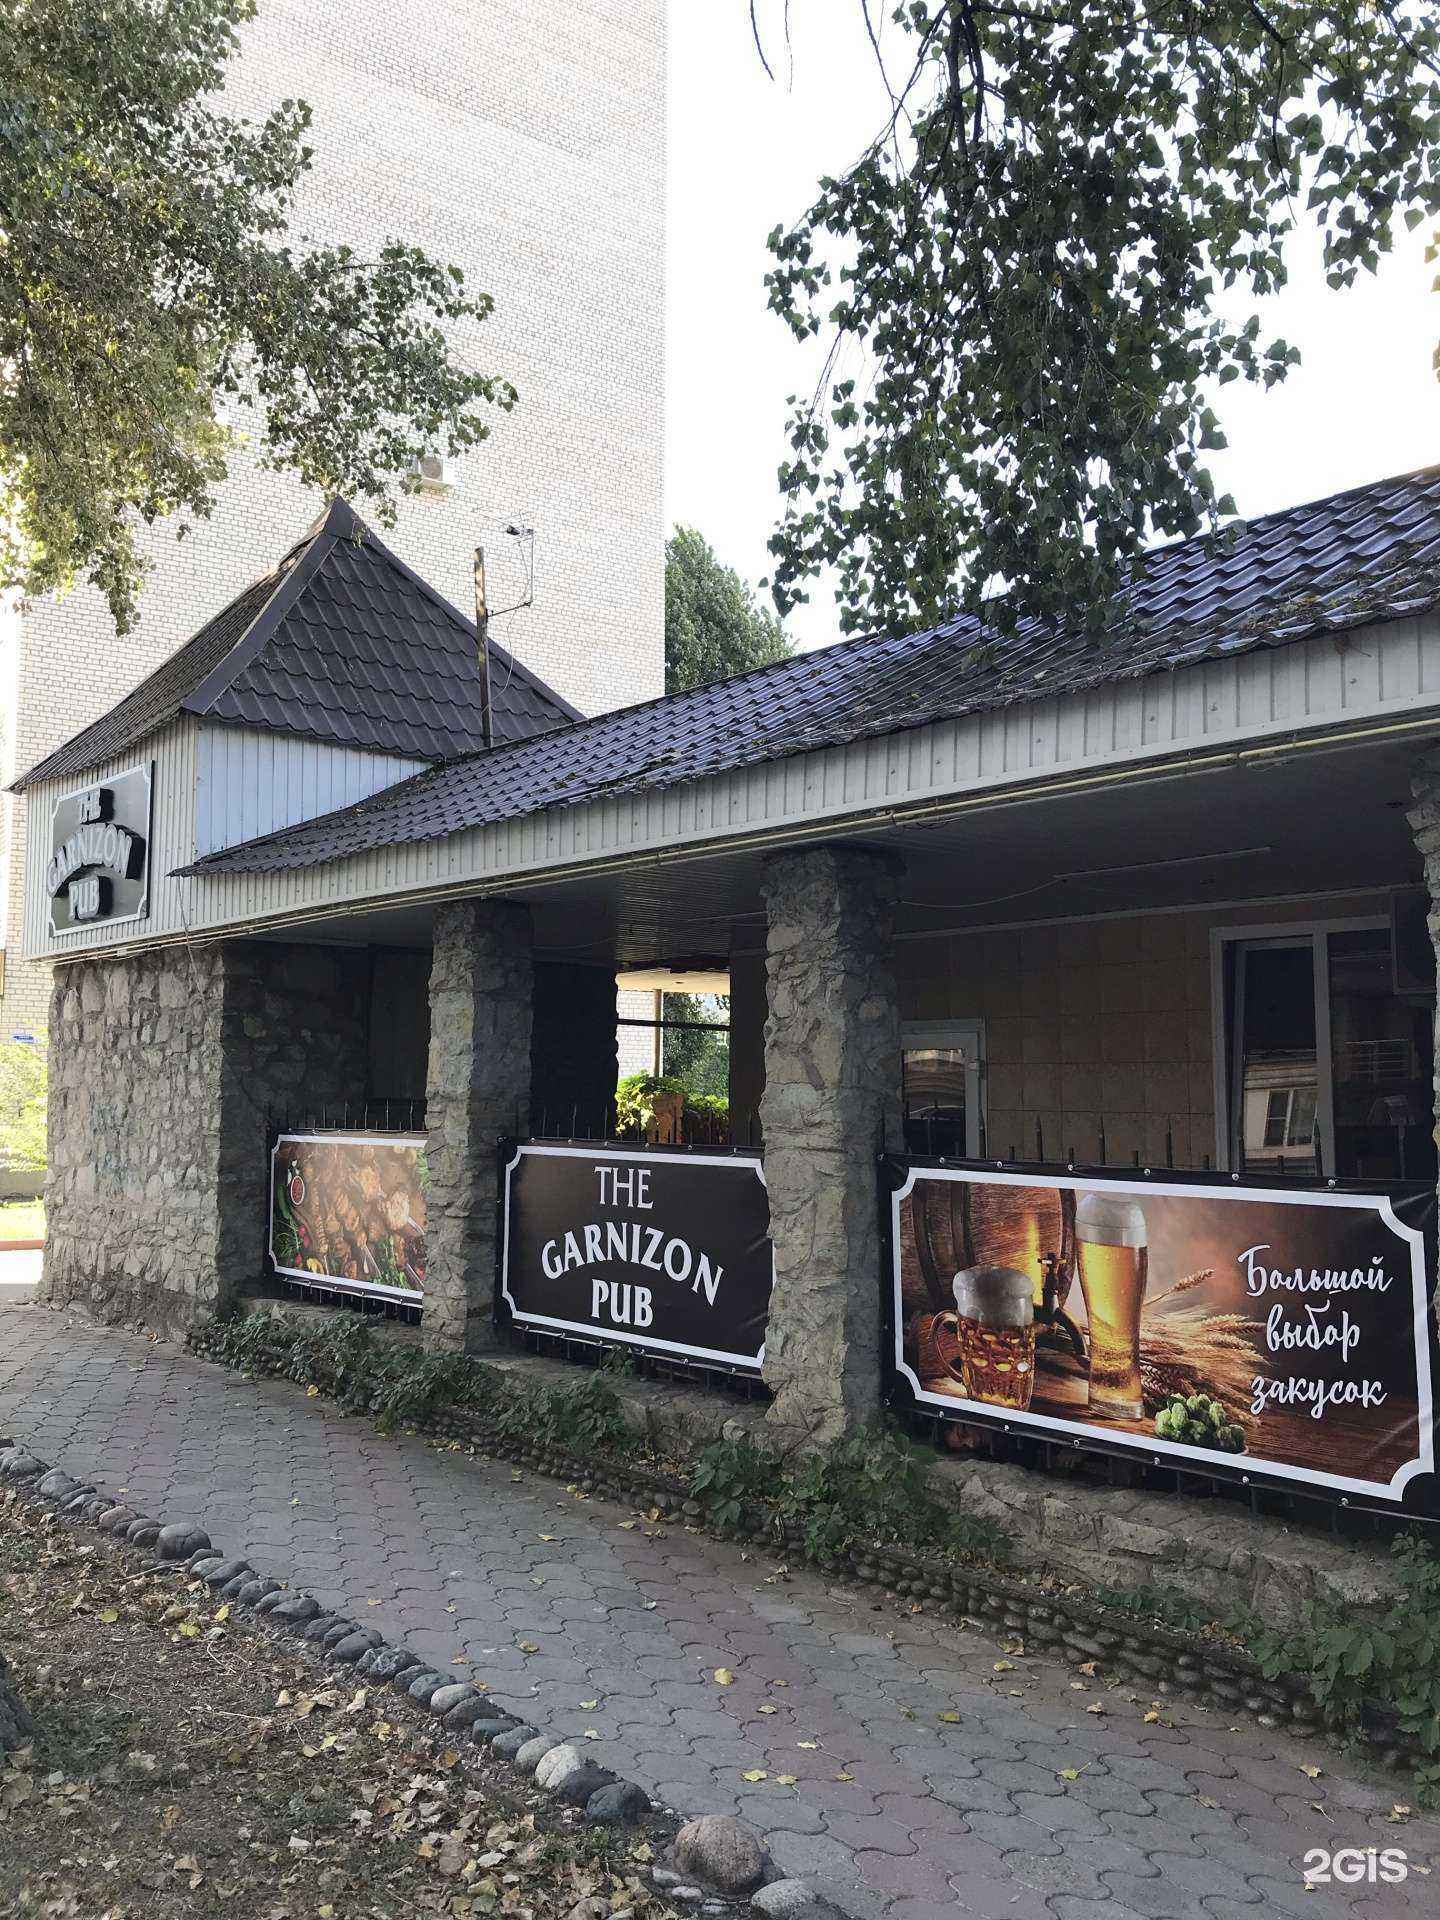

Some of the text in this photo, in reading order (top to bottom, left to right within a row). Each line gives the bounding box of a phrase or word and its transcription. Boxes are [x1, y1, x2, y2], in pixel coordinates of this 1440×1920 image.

[68, 878, 100, 919] PUB
[595, 1166, 653, 1209] THE
[541, 1221, 724, 1306] GARNIZON
[1238, 1244, 1393, 1296] Большой
[591, 1279, 653, 1327] PUB
[1266, 1300, 1360, 1363] выбор
[1250, 1375, 1388, 1419] закусок
